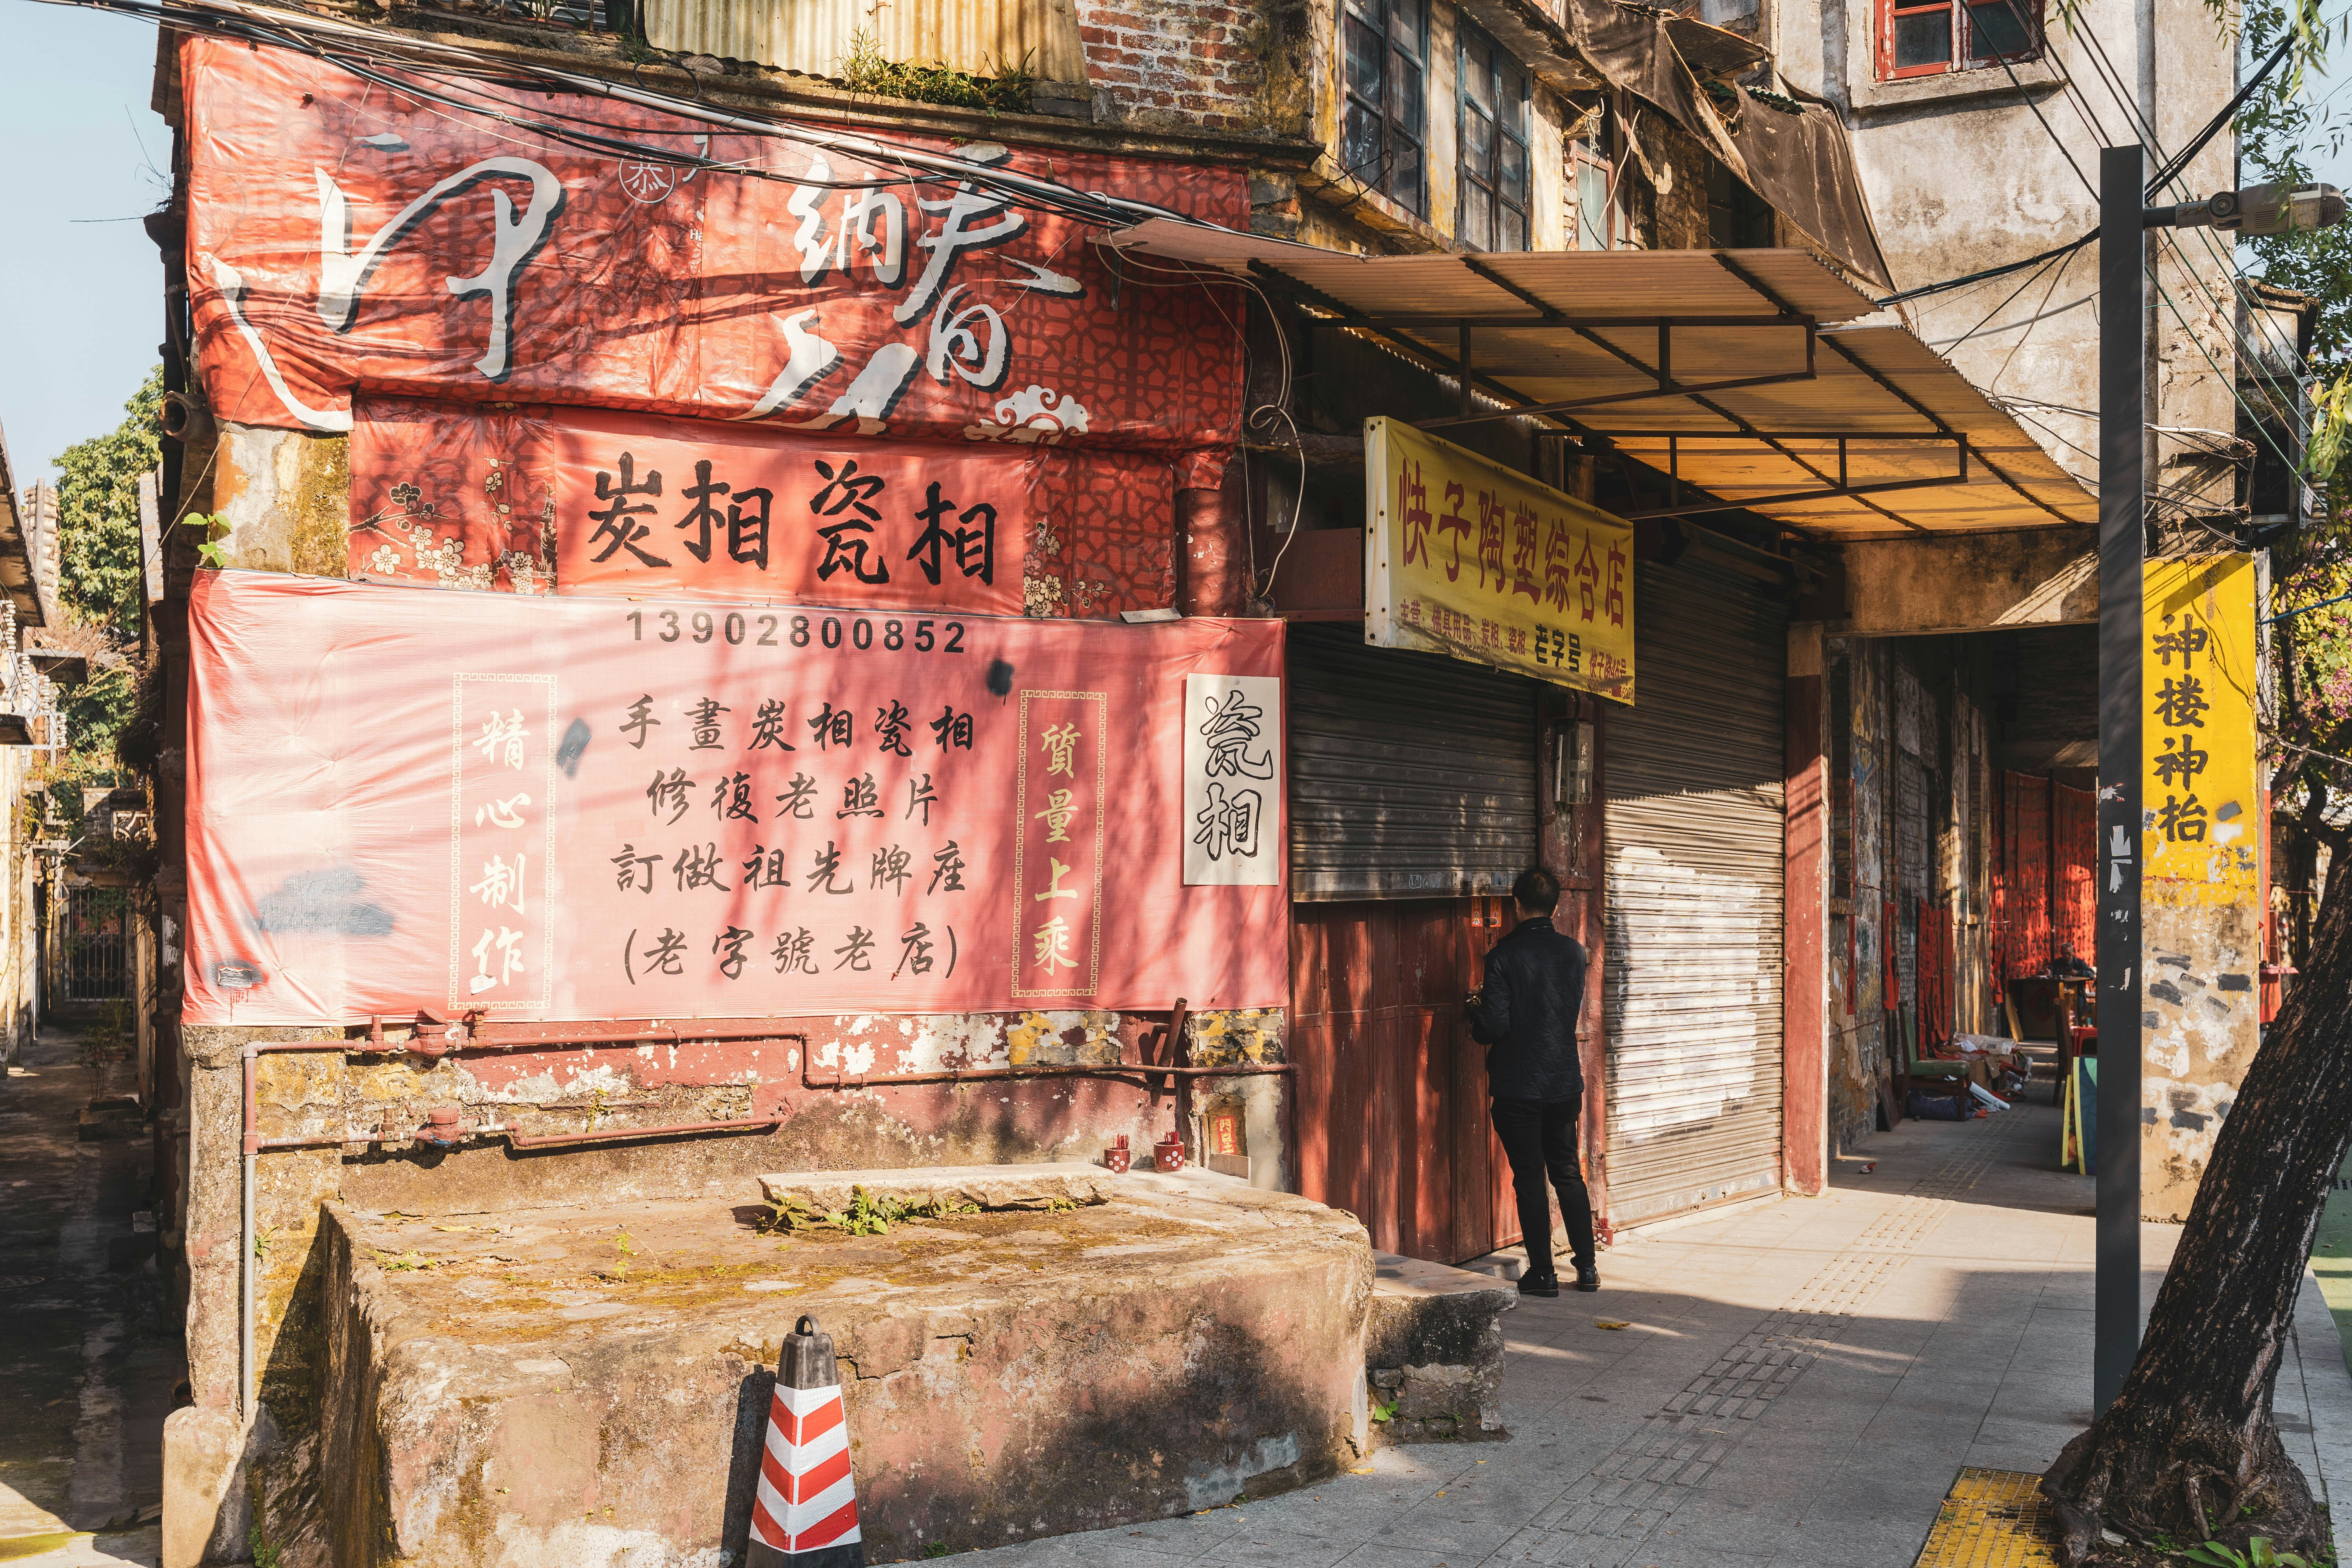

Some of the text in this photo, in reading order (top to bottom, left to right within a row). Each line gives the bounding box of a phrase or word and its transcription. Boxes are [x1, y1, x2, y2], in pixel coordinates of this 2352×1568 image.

[588, 451, 997, 586] 炭相瓷相
[1398, 457, 1626, 629] 快子陶塑综合店
[626, 608, 965, 653] 13902800852
[1535, 624, 1581, 673] 老字号
[619, 693, 973, 757] 手畫炭相瓷相
[646, 767, 938, 827] 修復老照片
[1193, 690, 1273, 861] 瓷相
[470, 708, 530, 987] 精心制作
[610, 840, 965, 897] 訂做祖先牌座
[1033, 722, 1082, 977] 質量上乘
